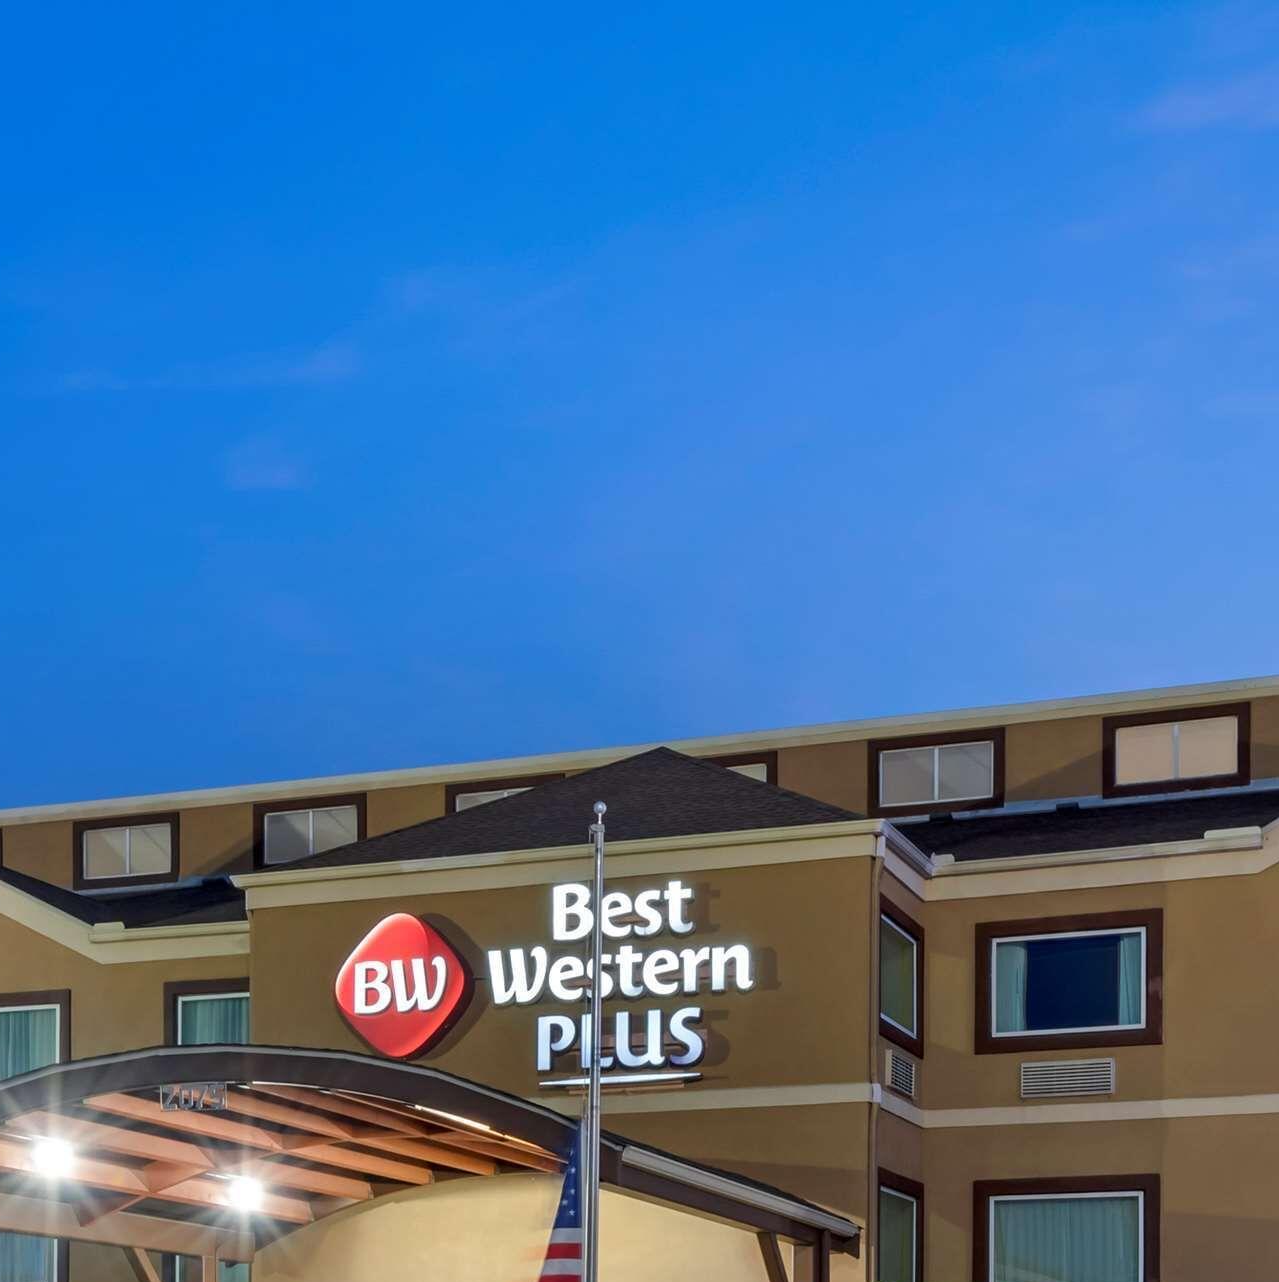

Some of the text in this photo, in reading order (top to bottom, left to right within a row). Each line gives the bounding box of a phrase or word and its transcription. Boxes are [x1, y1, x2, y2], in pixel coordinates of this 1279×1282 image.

[552, 880, 694, 941] Best
[354, 956, 446, 1015] BW
[488, 944, 754, 1004] Western
[537, 1007, 705, 1071] PLUS
